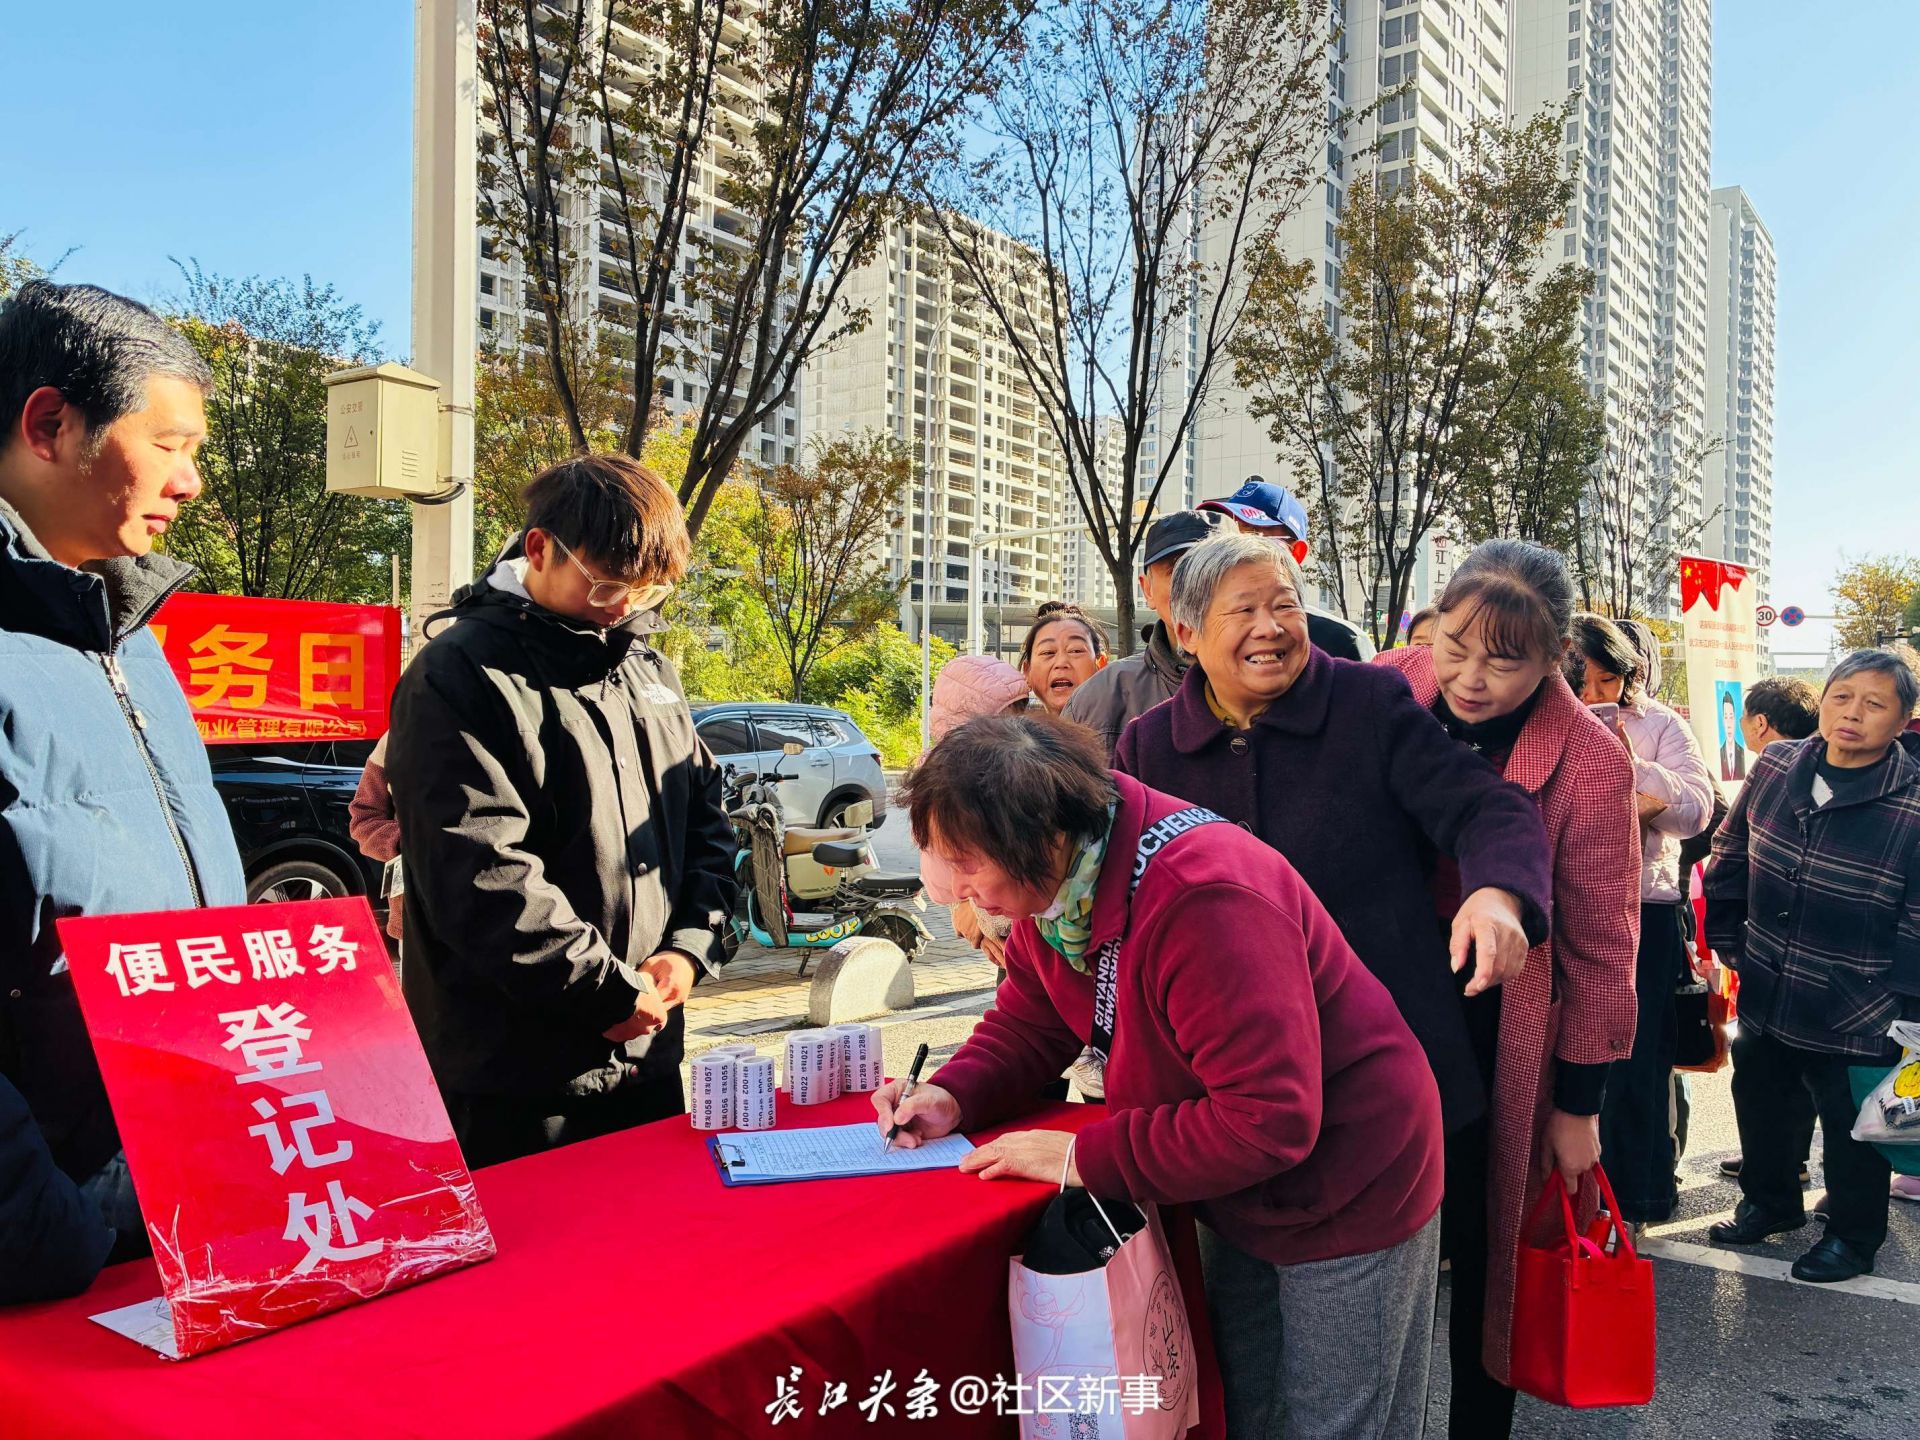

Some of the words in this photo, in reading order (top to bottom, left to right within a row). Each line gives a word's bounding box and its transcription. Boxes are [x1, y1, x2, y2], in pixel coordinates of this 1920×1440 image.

[1757, 610, 1773, 621] 30
[148, 624, 365, 710] 务日
[105, 924, 360, 997] 便民服务
[704, 1066, 712, 1095] 理发057
[218, 1001, 385, 1276] 登记处
[704, 1099, 712, 1128] 理发058
